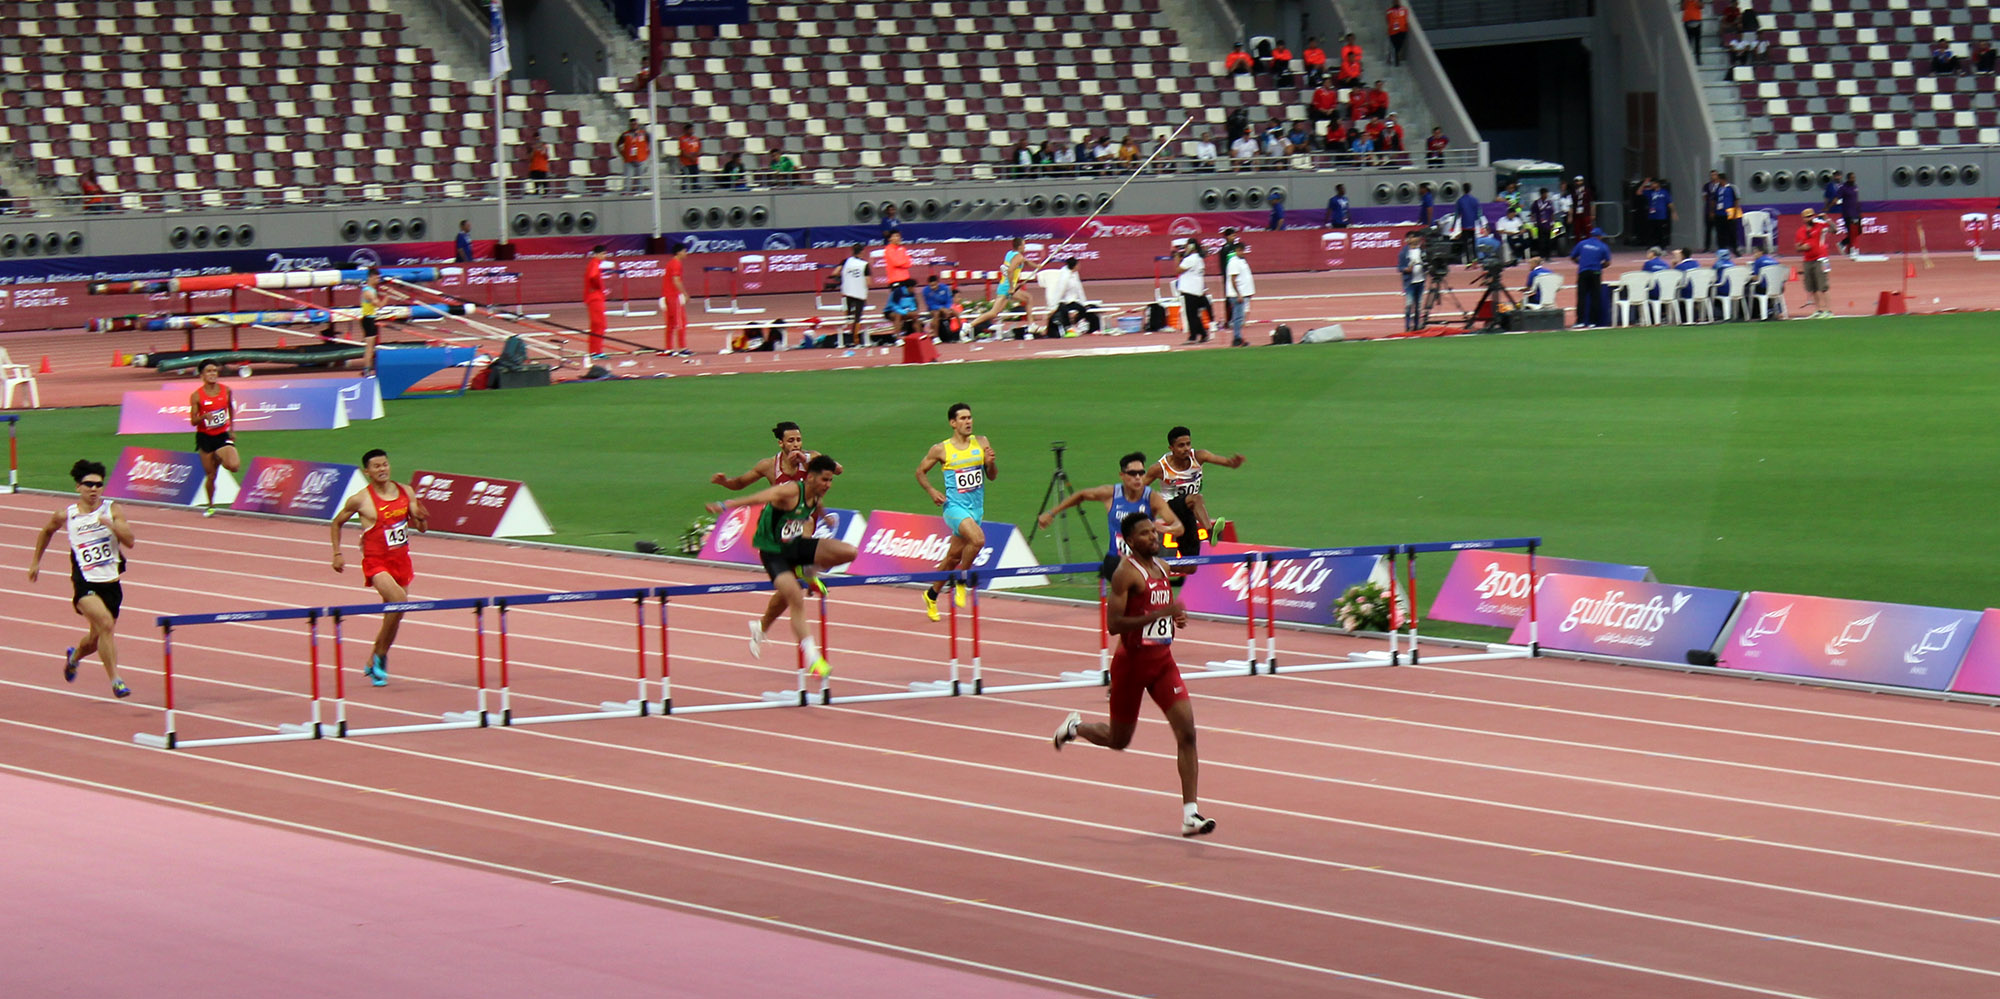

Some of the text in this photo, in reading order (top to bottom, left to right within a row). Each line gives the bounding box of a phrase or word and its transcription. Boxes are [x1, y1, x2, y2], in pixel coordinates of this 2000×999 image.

[1352, 232, 1391, 241] SPORT
[1352, 239, 1401, 249] FOR LIFE
[906, 248, 936, 257] PORT
[1074, 251, 1100, 260] LIFE
[769, 254, 808, 264] SPORT
[619, 260, 660, 270] SPORT
[769, 262, 819, 273] FOR LIFE
[14, 288, 57, 299] SPORT
[14, 296, 70, 309] FOR LIFE
[958, 471, 982, 487] 606
[389, 528, 408, 543] 43
[83, 544, 111, 562] 636
[1559, 590, 1672, 632] gulfcrafts
